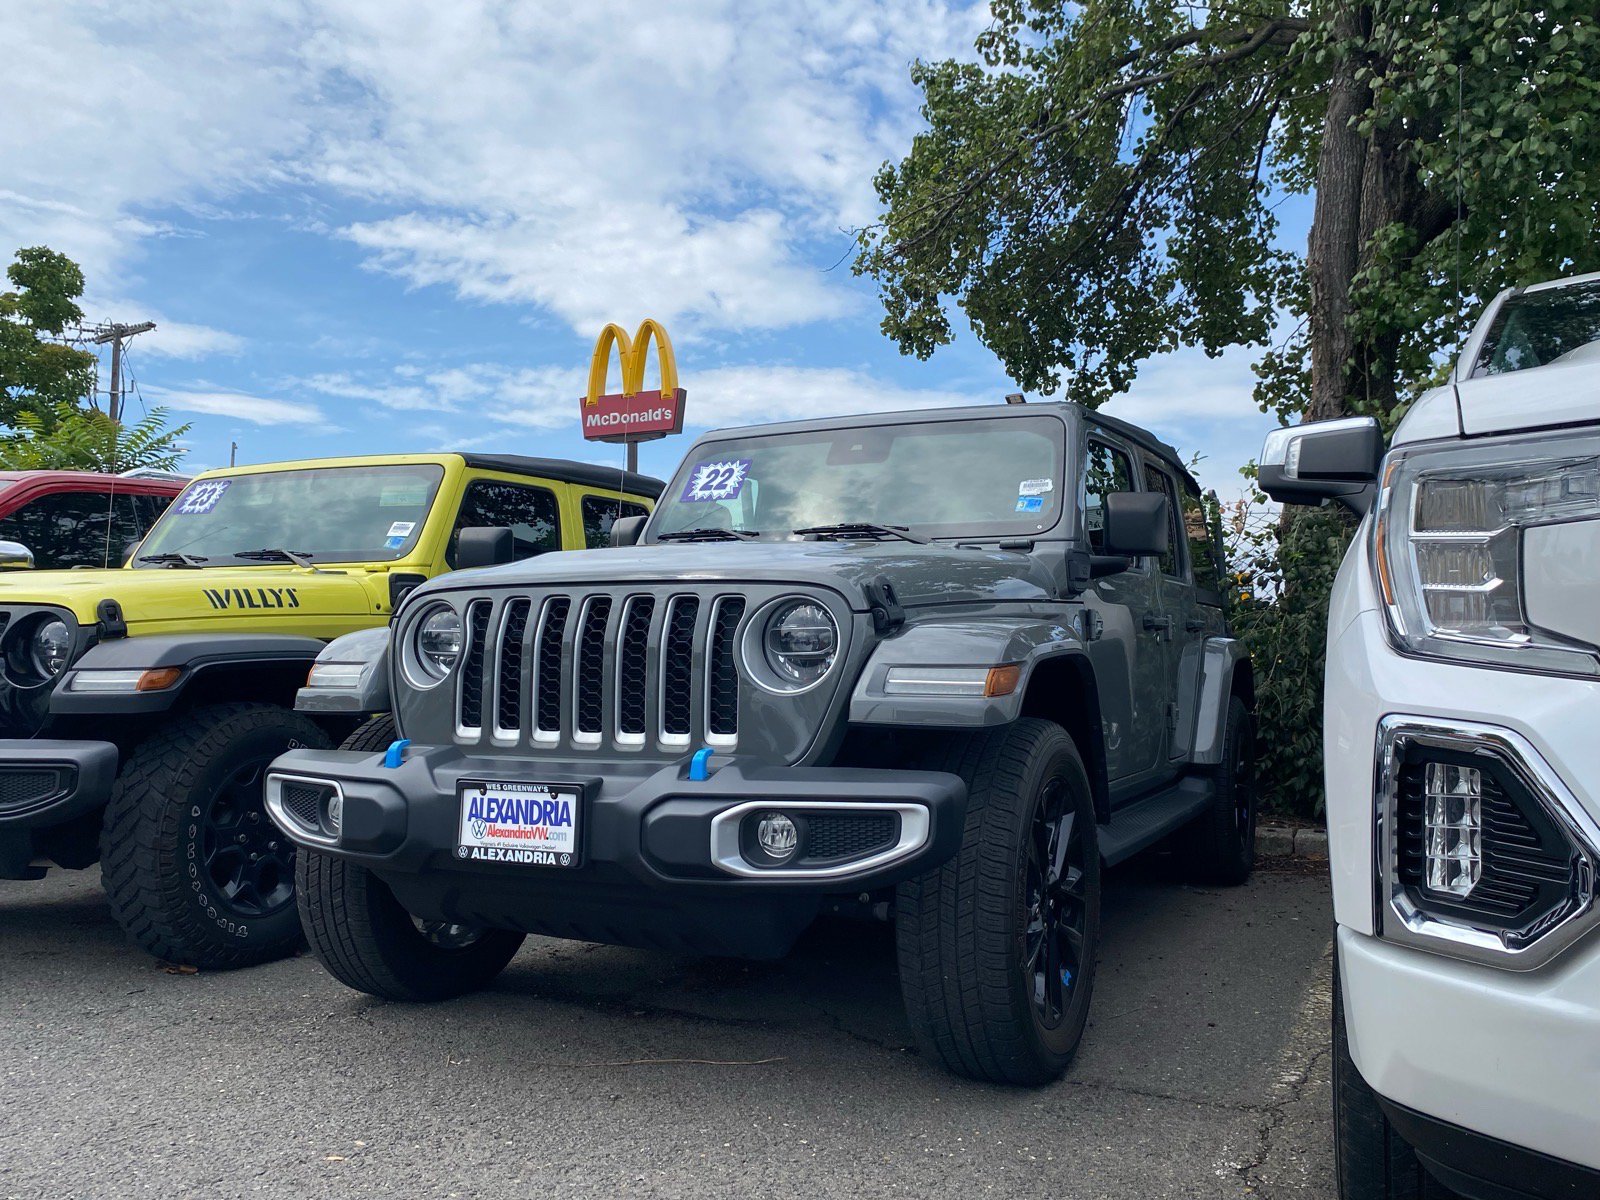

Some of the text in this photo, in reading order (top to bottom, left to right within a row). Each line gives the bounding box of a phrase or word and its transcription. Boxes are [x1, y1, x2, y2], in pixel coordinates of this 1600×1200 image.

[586, 407, 673, 427] McDonald's
[698, 467, 735, 491] 22
[187, 487, 217, 507] 23
[202, 588, 300, 610] WILLYS
[486, 783, 549, 793] WES GREENWAY'S
[467, 797, 572, 827] ALEXANDRIA
[487, 824, 567, 842] AlexandriaVW.com
[470, 847, 556, 865] ALEXANDRIA
